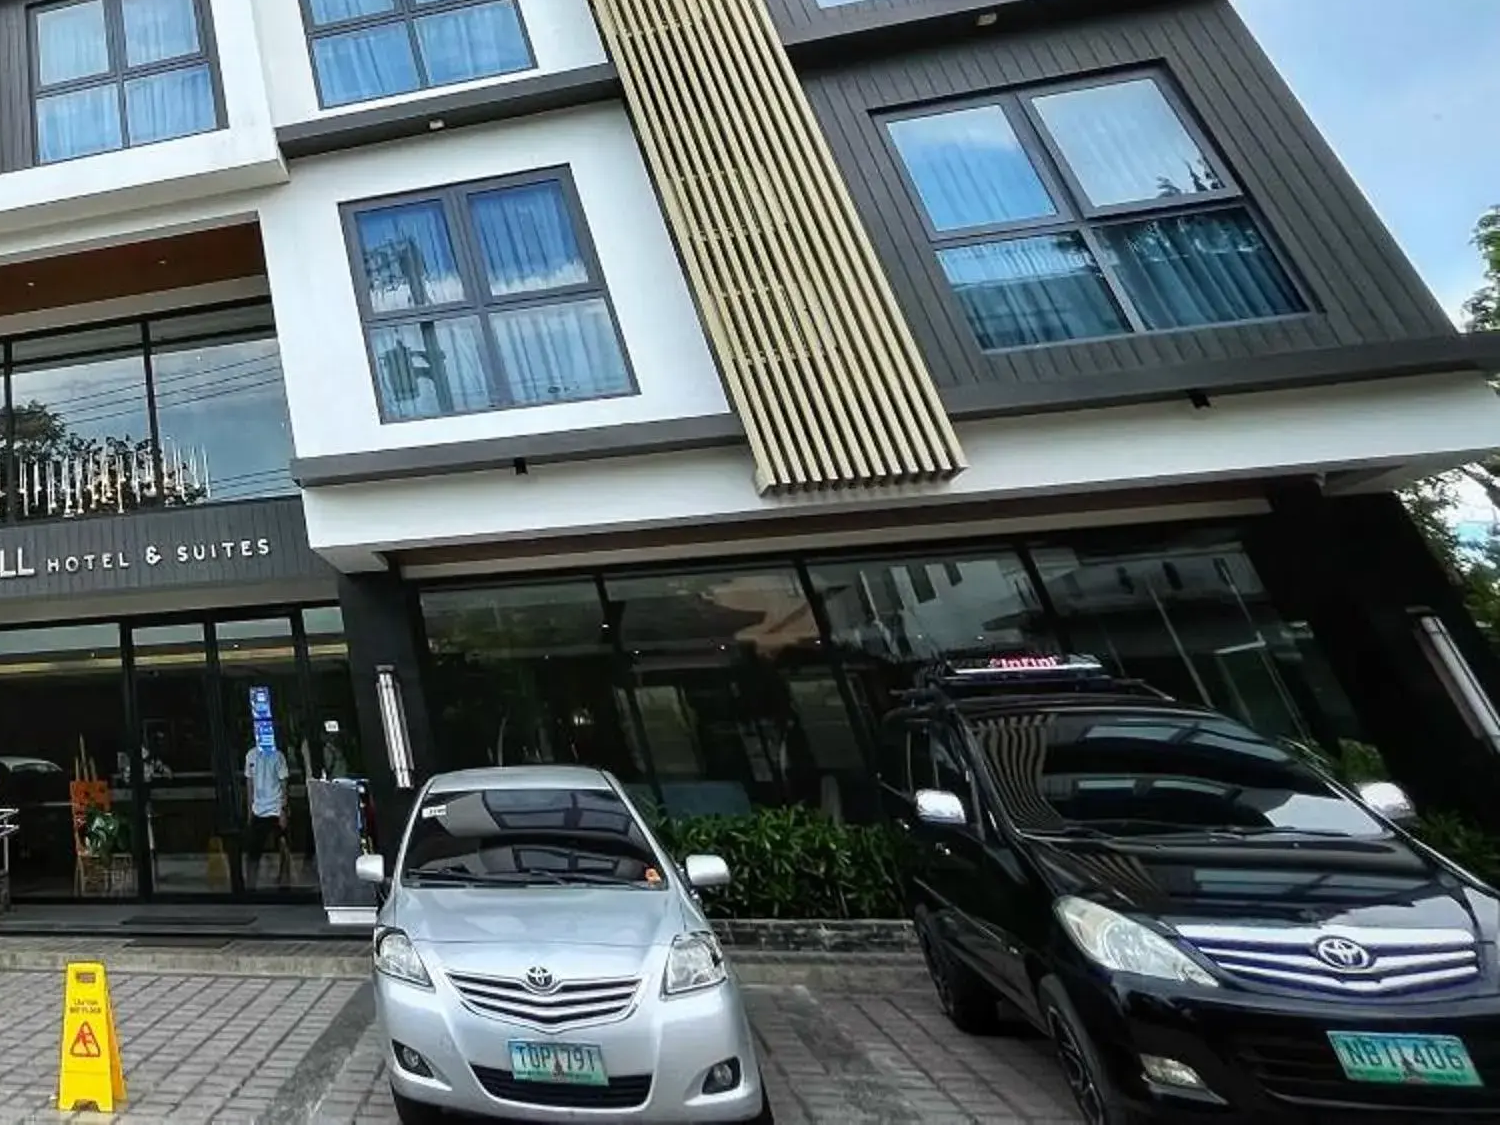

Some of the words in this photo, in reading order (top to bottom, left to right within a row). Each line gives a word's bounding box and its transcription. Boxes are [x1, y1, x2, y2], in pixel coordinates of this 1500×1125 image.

[47, 551, 130, 573] HOTEL
[145, 545, 163, 566] &
[176, 538, 270, 563] SUITES
